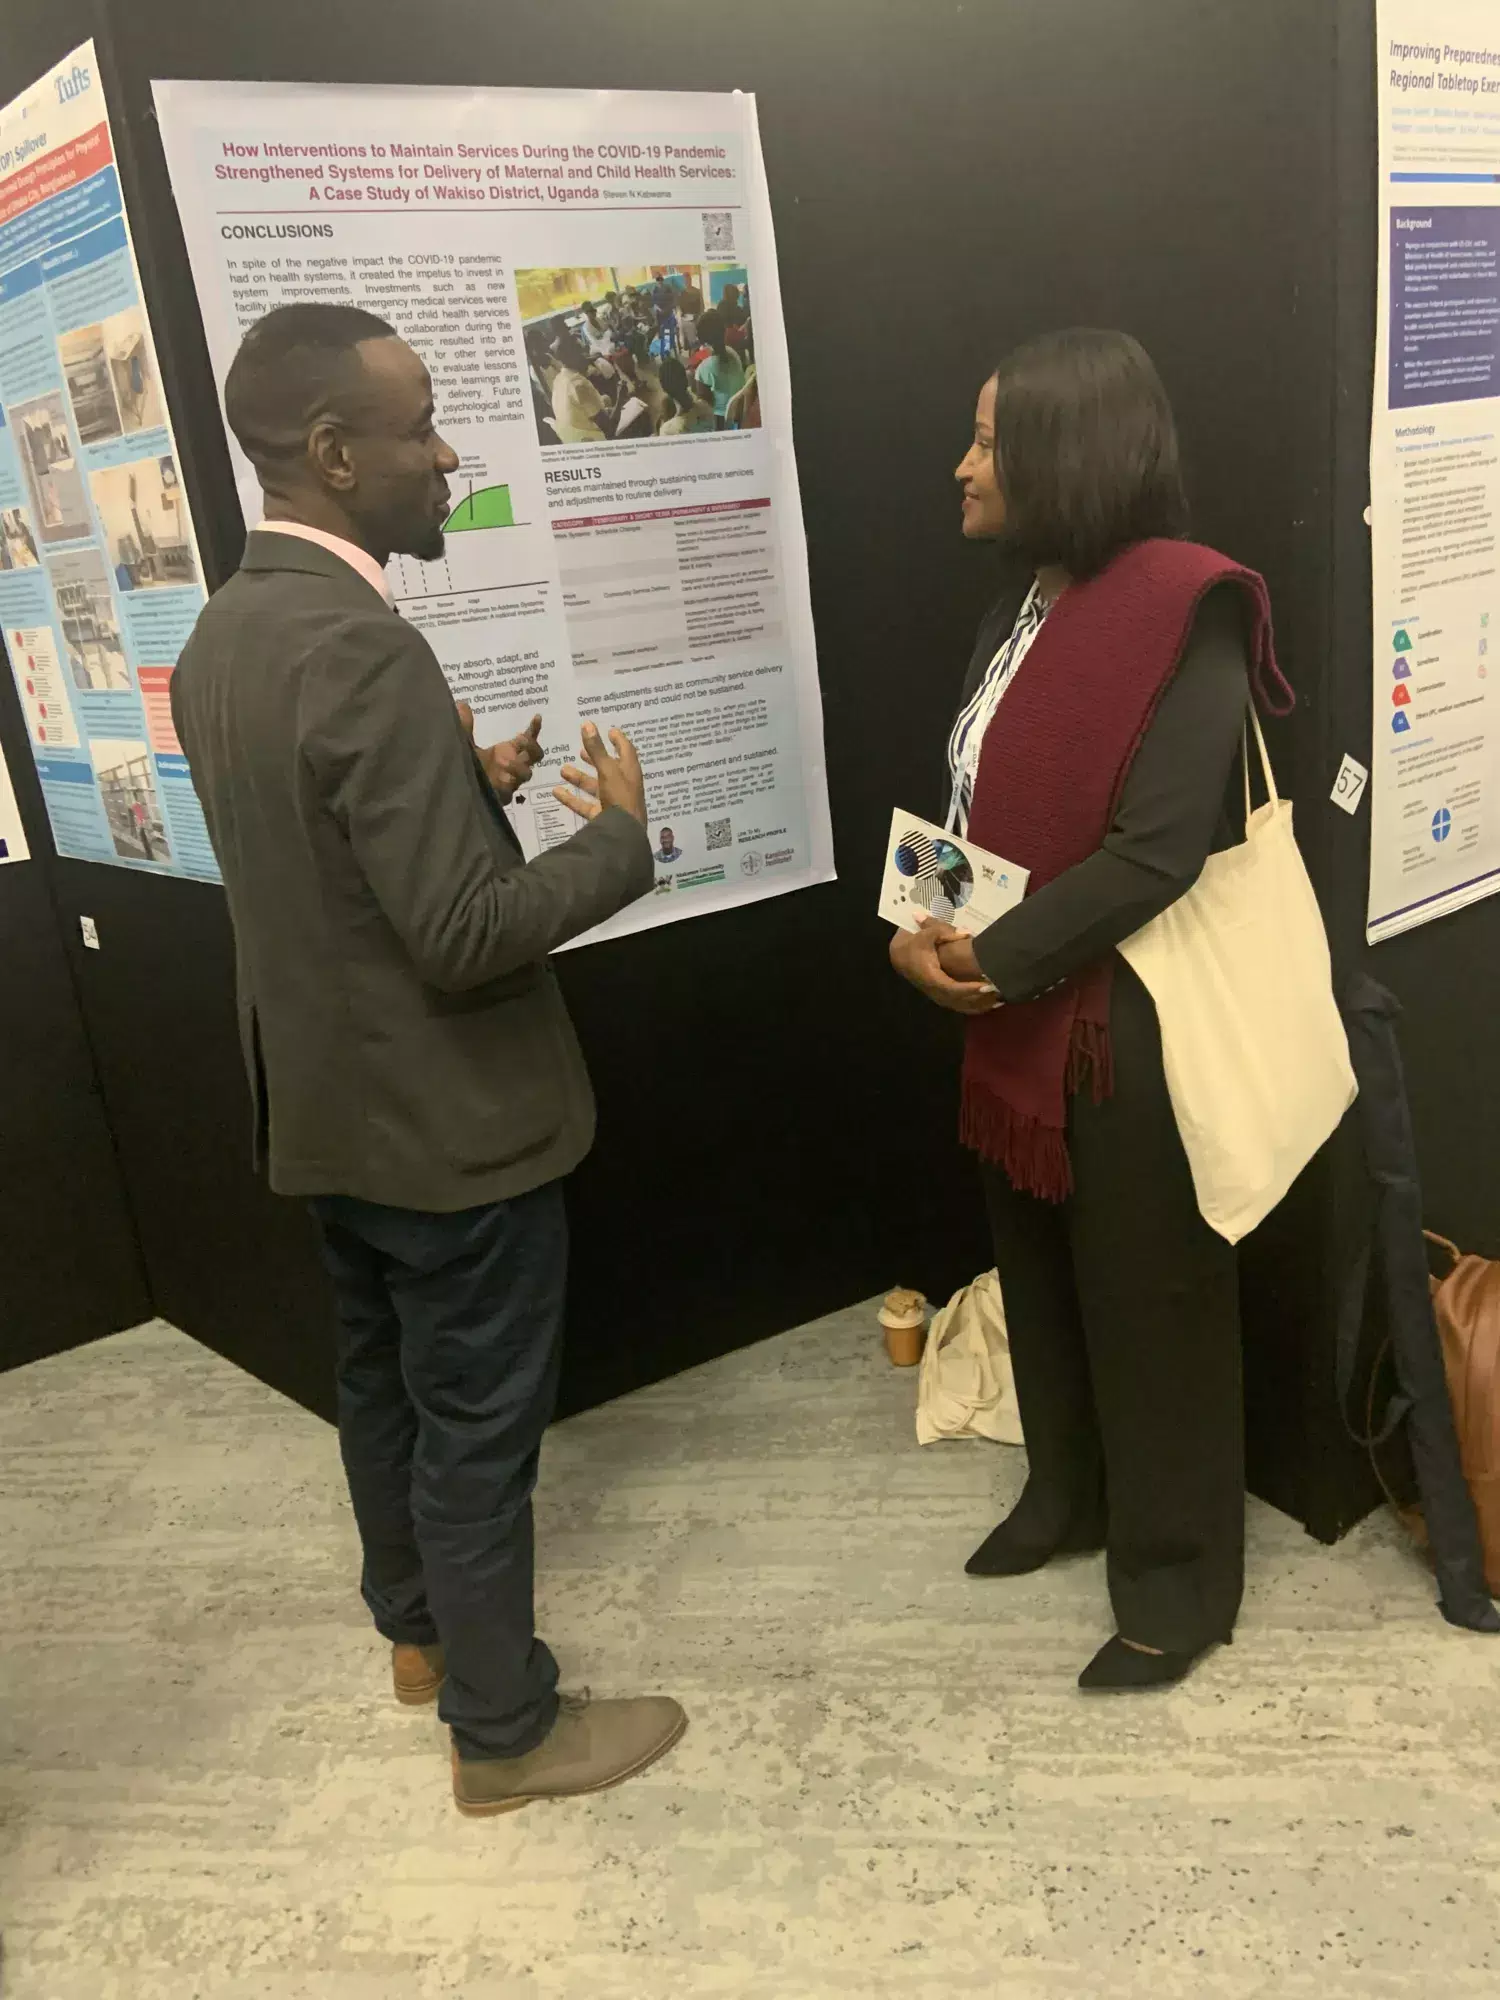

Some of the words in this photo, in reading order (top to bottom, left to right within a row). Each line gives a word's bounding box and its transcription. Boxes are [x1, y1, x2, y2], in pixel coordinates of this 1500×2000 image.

[1390, 40, 1441, 64] Improving
[54, 66, 90, 104] Tufts
[1390, 70, 1434, 92] Regional
[1437, 73, 1478, 95] Tabletop
[1481, 76, 1500, 92] Exer
[15, 132, 47, 162] Spillover
[222, 143, 258, 157] How
[263, 144, 367, 157] Interventions
[371, 144, 386, 157] to
[390, 144, 454, 157] Maintain
[458, 144, 519, 158] Services
[522, 145, 569, 161] During
[573, 146, 594, 158] the
[598, 145, 660, 158] COVID-19
[664, 146, 726, 158] Pandemic
[215, 165, 324, 182] Strengthened
[328, 165, 394, 182] Systems
[398, 165, 419, 178] for
[424, 165, 481, 182] Delivery
[486, 165, 499, 179] of
[504, 165, 563, 178] Maternal
[568, 166, 592, 178] and
[597, 165, 631, 178] Child
[634, 166, 676, 178] Health
[679, 165, 736, 178] Services:
[310, 186, 320, 200] A
[324, 186, 362, 200] Case
[367, 186, 410, 202] Study
[415, 186, 429, 199] of
[433, 186, 485, 199] Wakiso
[489, 186, 544, 200] District,
[548, 186, 599, 202] Uganda
[221, 225, 333, 238] CONCLUSIONS
[1396, 218, 1432, 231] Background
[227, 259, 237, 268] In
[242, 260, 266, 270] spite
[271, 258, 280, 268] of
[286, 258, 301, 267] the
[307, 258, 347, 269] negative
[352, 257, 384, 267] impact
[388, 256, 403, 265] the
[408, 255, 454, 264] COVID-19
[459, 256, 501, 265] pandemic
[230, 274, 249, 283] had
[269, 272, 300, 282] health
[350, 271, 356, 280] it
[359, 270, 395, 280] created
[398, 270, 412, 278] the
[416, 270, 452, 279] impetus
[454, 269, 463, 278] to
[467, 269, 492, 277] invest
[232, 289, 268, 299] system
[365, 284, 421, 293] Investments
[433, 283, 454, 292] such
[235, 302, 266, 312] facility
[356, 299, 408, 309] emergency
[411, 296, 445, 305] medical
[396, 311, 412, 320] and
[417, 310, 438, 319] child
[442, 310, 469, 318] health
[474, 310, 510, 318] services
[404, 324, 460, 333] collaboration
[465, 323, 492, 332] during
[497, 321, 511, 330] the
[407, 339, 434, 348] demic
[440, 336, 474, 345] resulted
[435, 350, 446, 359] for
[454, 350, 476, 358] other
[485, 349, 515, 357] service
[430, 364, 438, 373] to
[443, 364, 480, 372] evaluate
[461, 376, 500, 385] learnings
[493, 387, 521, 395] Future
[443, 401, 500, 413] psychological
[507, 399, 523, 408] and
[437, 417, 471, 425] workers
[489, 413, 524, 421] maintain
[1395, 424, 1435, 438] Methodology
[545, 468, 602, 482] RESULTS
[546, 486, 582, 495] Services
[584, 481, 627, 491] maintained
[628, 478, 658, 487] through
[660, 475, 697, 484] sustaining
[725, 469, 754, 478] services
[548, 499, 564, 508] and
[566, 495, 614, 506] adjustments
[626, 491, 652, 499] routine
[653, 488, 682, 497] delivery
[442, 663, 460, 673] they
[524, 651, 539, 660] and
[458, 670, 494, 680] Although
[496, 664, 537, 675] absorptive
[540, 660, 555, 669] and
[451, 680, 507, 694] demonstrated
[509, 676, 534, 685] during
[577, 696, 602, 705] Some
[603, 688, 652, 701] adjustments
[654, 684, 673, 693] such
[686, 675, 726, 687] community
[728, 670, 753, 680] service
[755, 666, 782, 675] delivery
[474, 688, 524, 702] documented
[526, 685, 548, 694] about
[488, 703, 516, 712] service
[518, 698, 549, 707] delivery
[579, 708, 599, 716] were
[601, 702, 642, 713] temporary
[644, 697, 659, 706] and
[661, 694, 681, 703] could
[683, 691, 696, 699] not
[551, 744, 570, 753] child
[686, 758, 726, 773] permanent
[728, 754, 742, 764] and
[1337, 766, 1364, 800] 57
